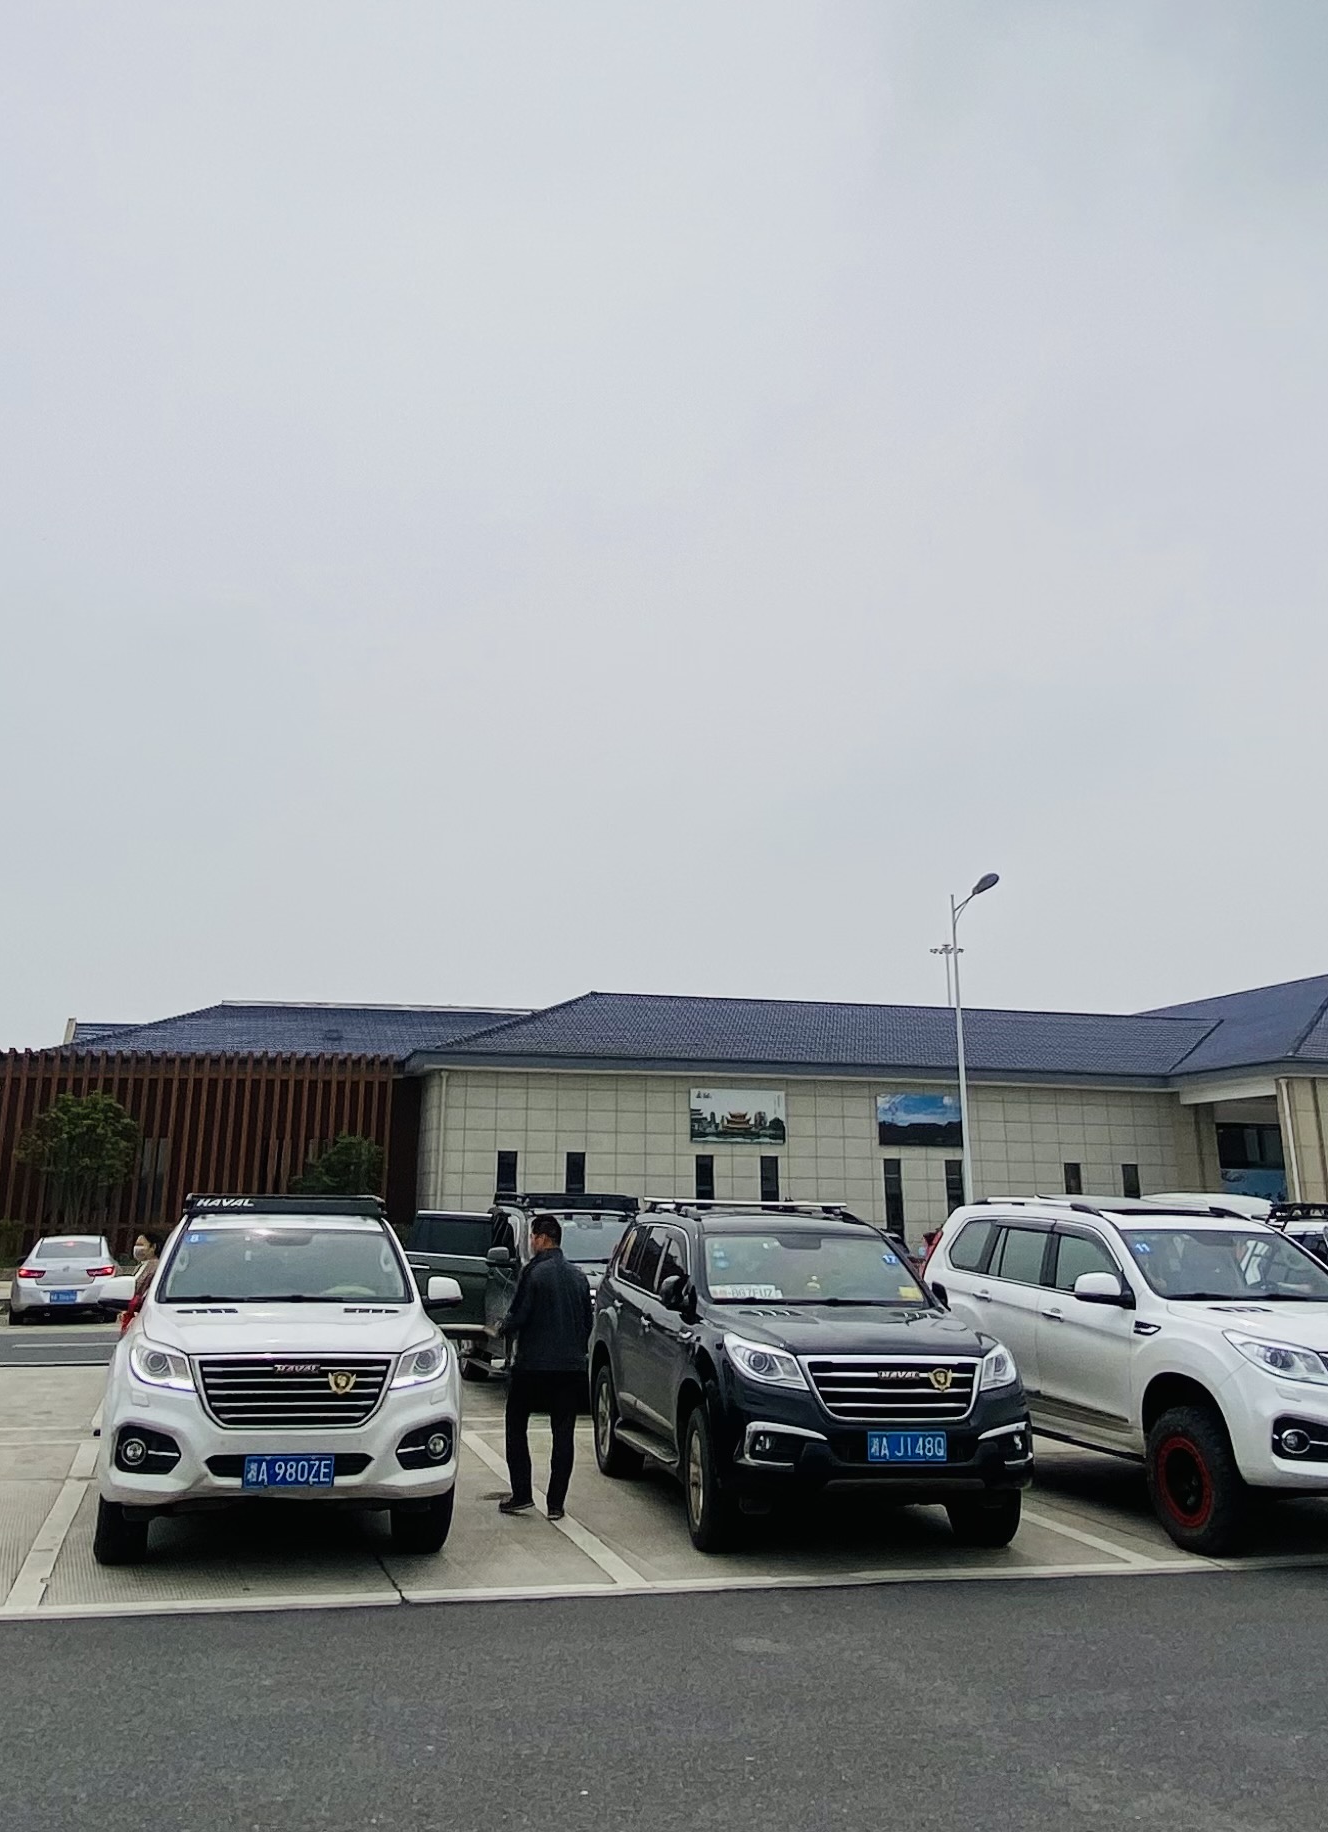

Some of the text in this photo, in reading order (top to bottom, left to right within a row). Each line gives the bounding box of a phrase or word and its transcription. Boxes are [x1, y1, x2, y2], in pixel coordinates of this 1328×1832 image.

[196, 1198, 255, 1207] HAVAL
[895, 1436, 945, 1457] J148Q
[275, 1460, 331, 1482] 980ZE
